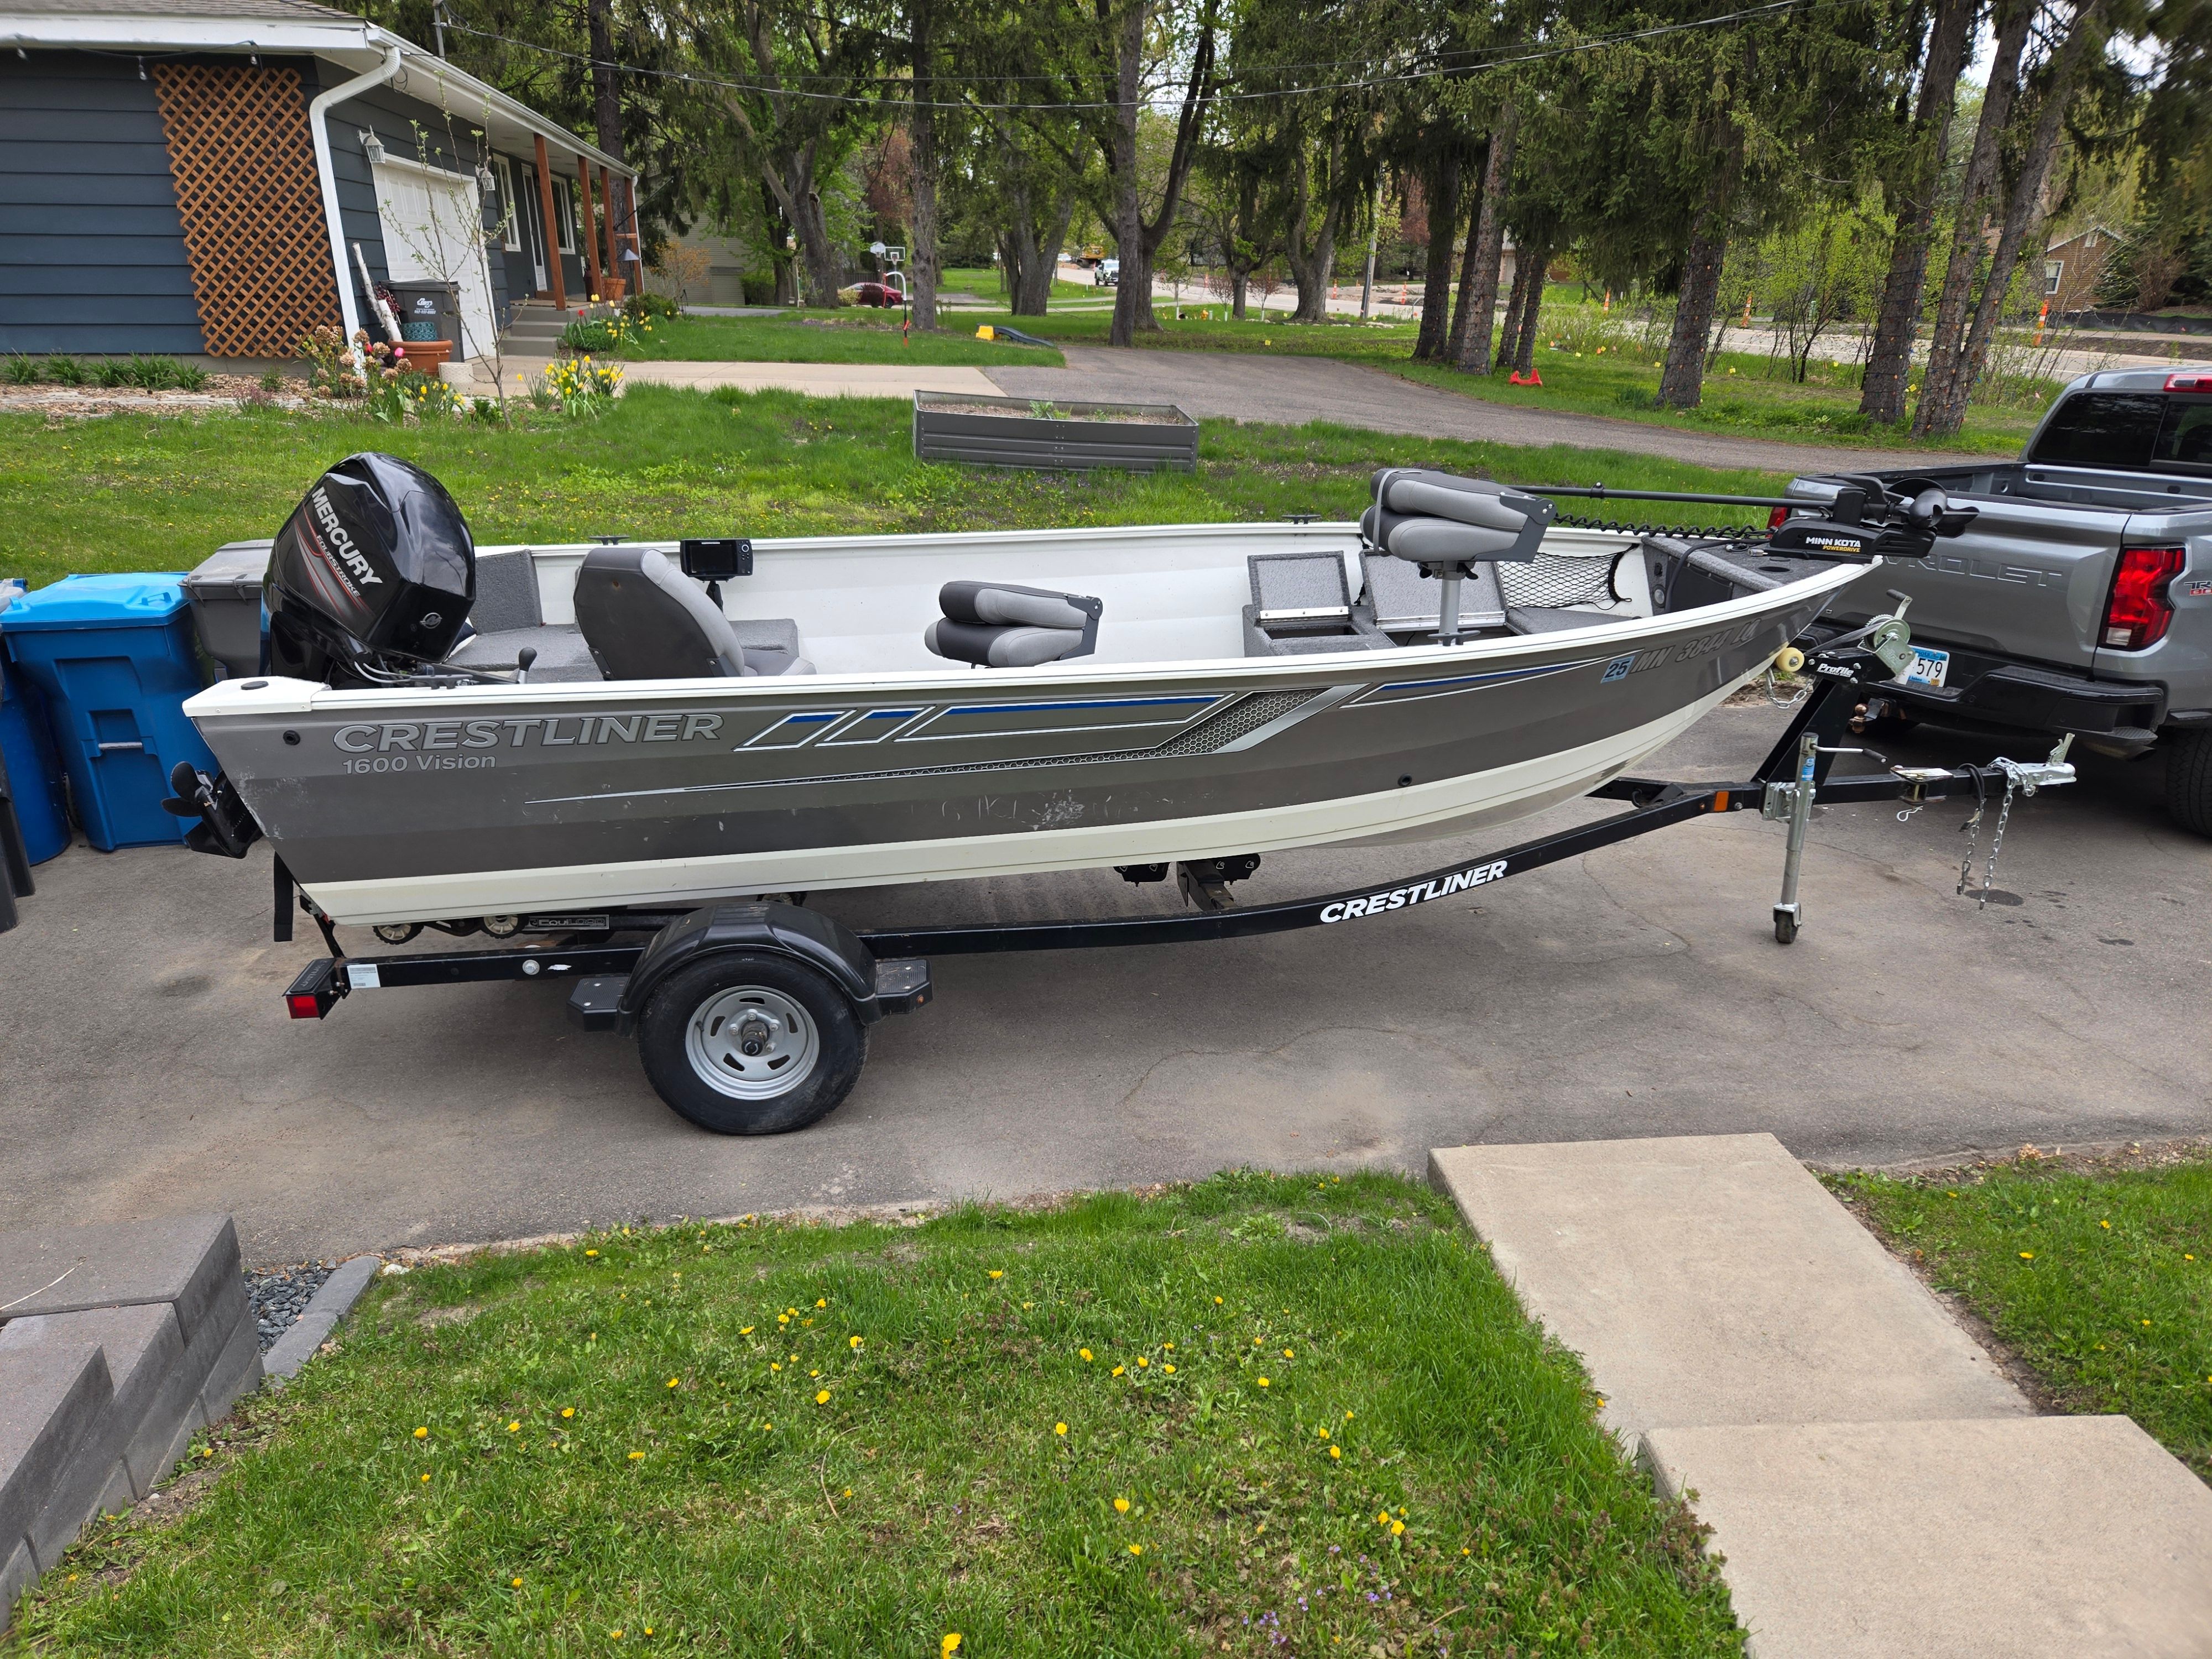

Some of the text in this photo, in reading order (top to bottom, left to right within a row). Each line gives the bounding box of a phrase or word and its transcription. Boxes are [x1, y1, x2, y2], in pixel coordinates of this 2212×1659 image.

[312, 487, 383, 585] MERCURY
[1806, 537, 1861, 547] MINN KOTA
[316, 535, 361, 598] FOURSTROKE
[1604, 660, 1630, 679] 25
[1629, 645, 1676, 674] MN
[1675, 628, 1735, 662] 3844
[1817, 663, 1854, 675] Profile
[1917, 658, 1943, 678] 579
[333, 713, 724, 754] CRESTLINER
[343, 754, 497, 774] 1600 Vision
[1319, 860, 1508, 924] CRESTLINER
